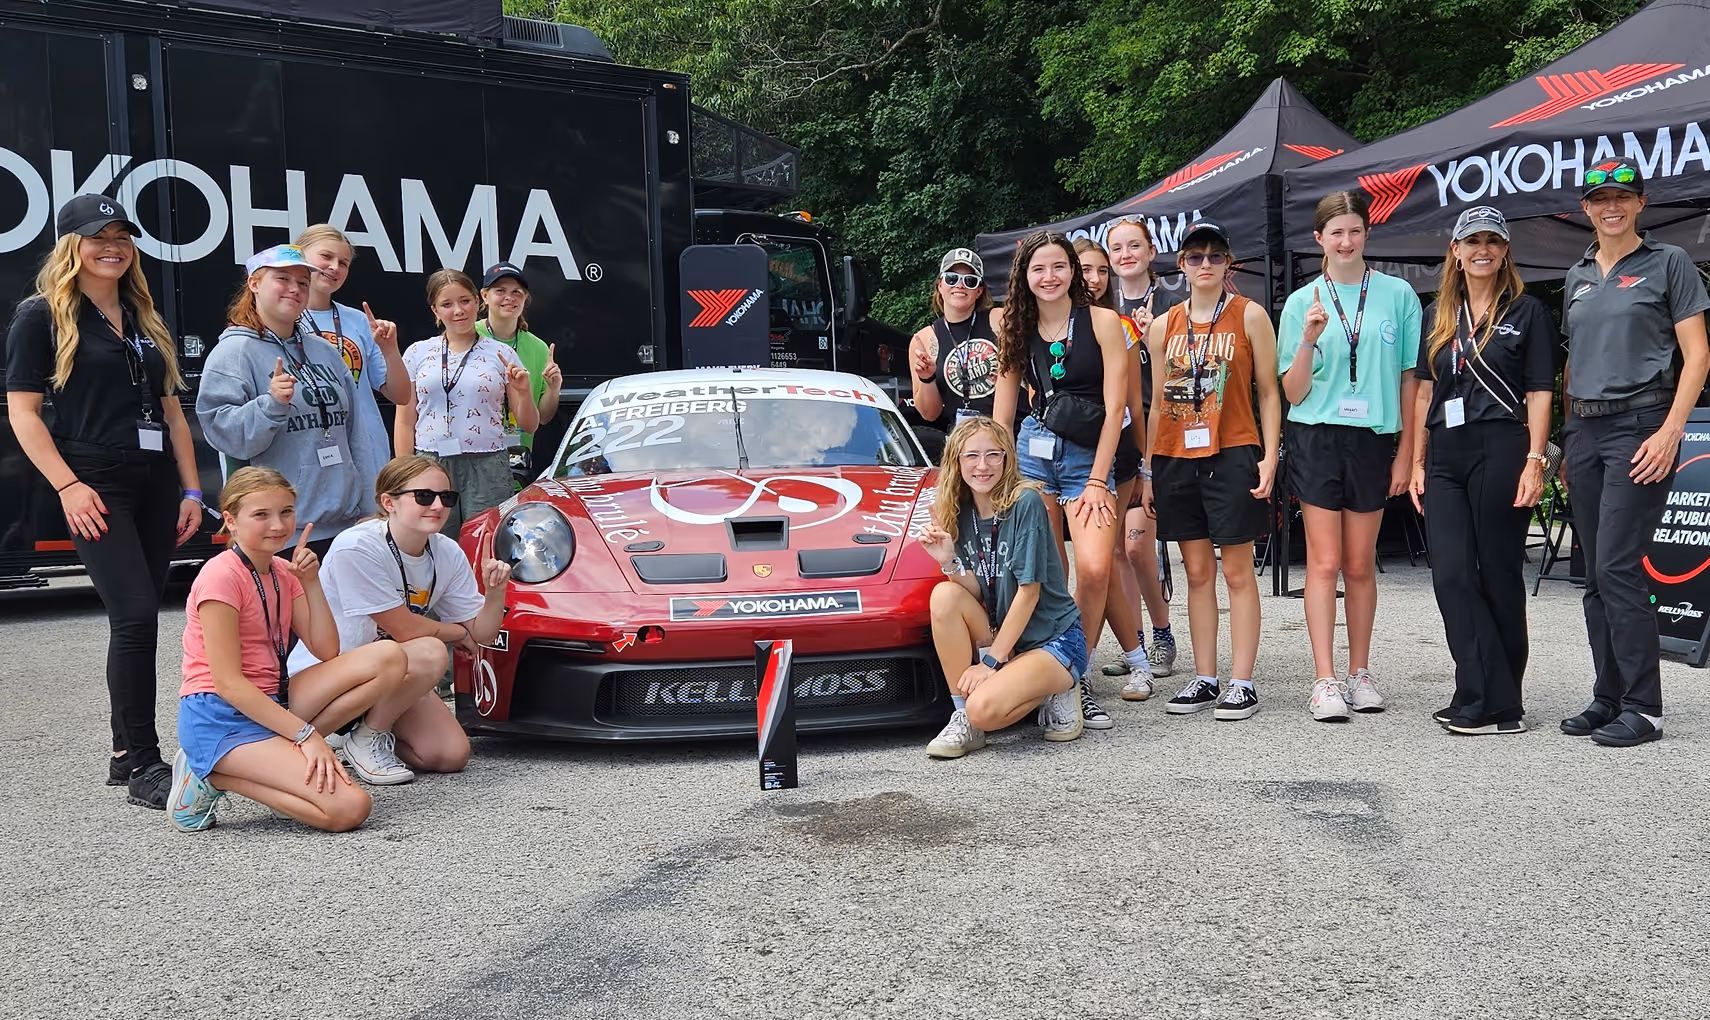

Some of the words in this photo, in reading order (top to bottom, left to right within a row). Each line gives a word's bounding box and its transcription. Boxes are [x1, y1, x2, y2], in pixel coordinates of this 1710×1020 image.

[1168, 147, 1264, 193] YOKOHAMA
[725, 288, 765, 326] YOKOHAMA
[1166, 332, 1236, 362] MUTANG
[966, 361, 988, 381] AND
[967, 352, 986, 370] AZZ
[600, 385, 876, 408] WeatherTech
[609, 400, 747, 424] FREIBERG
[565, 415, 686, 467] 222
[1666, 491, 1710, 507] ARKET
[1661, 509, 1673, 524] &
[1673, 511, 1710, 526] PUBLI
[1653, 528, 1710, 546] RELATION
[644, 679, 758, 704] KELL
